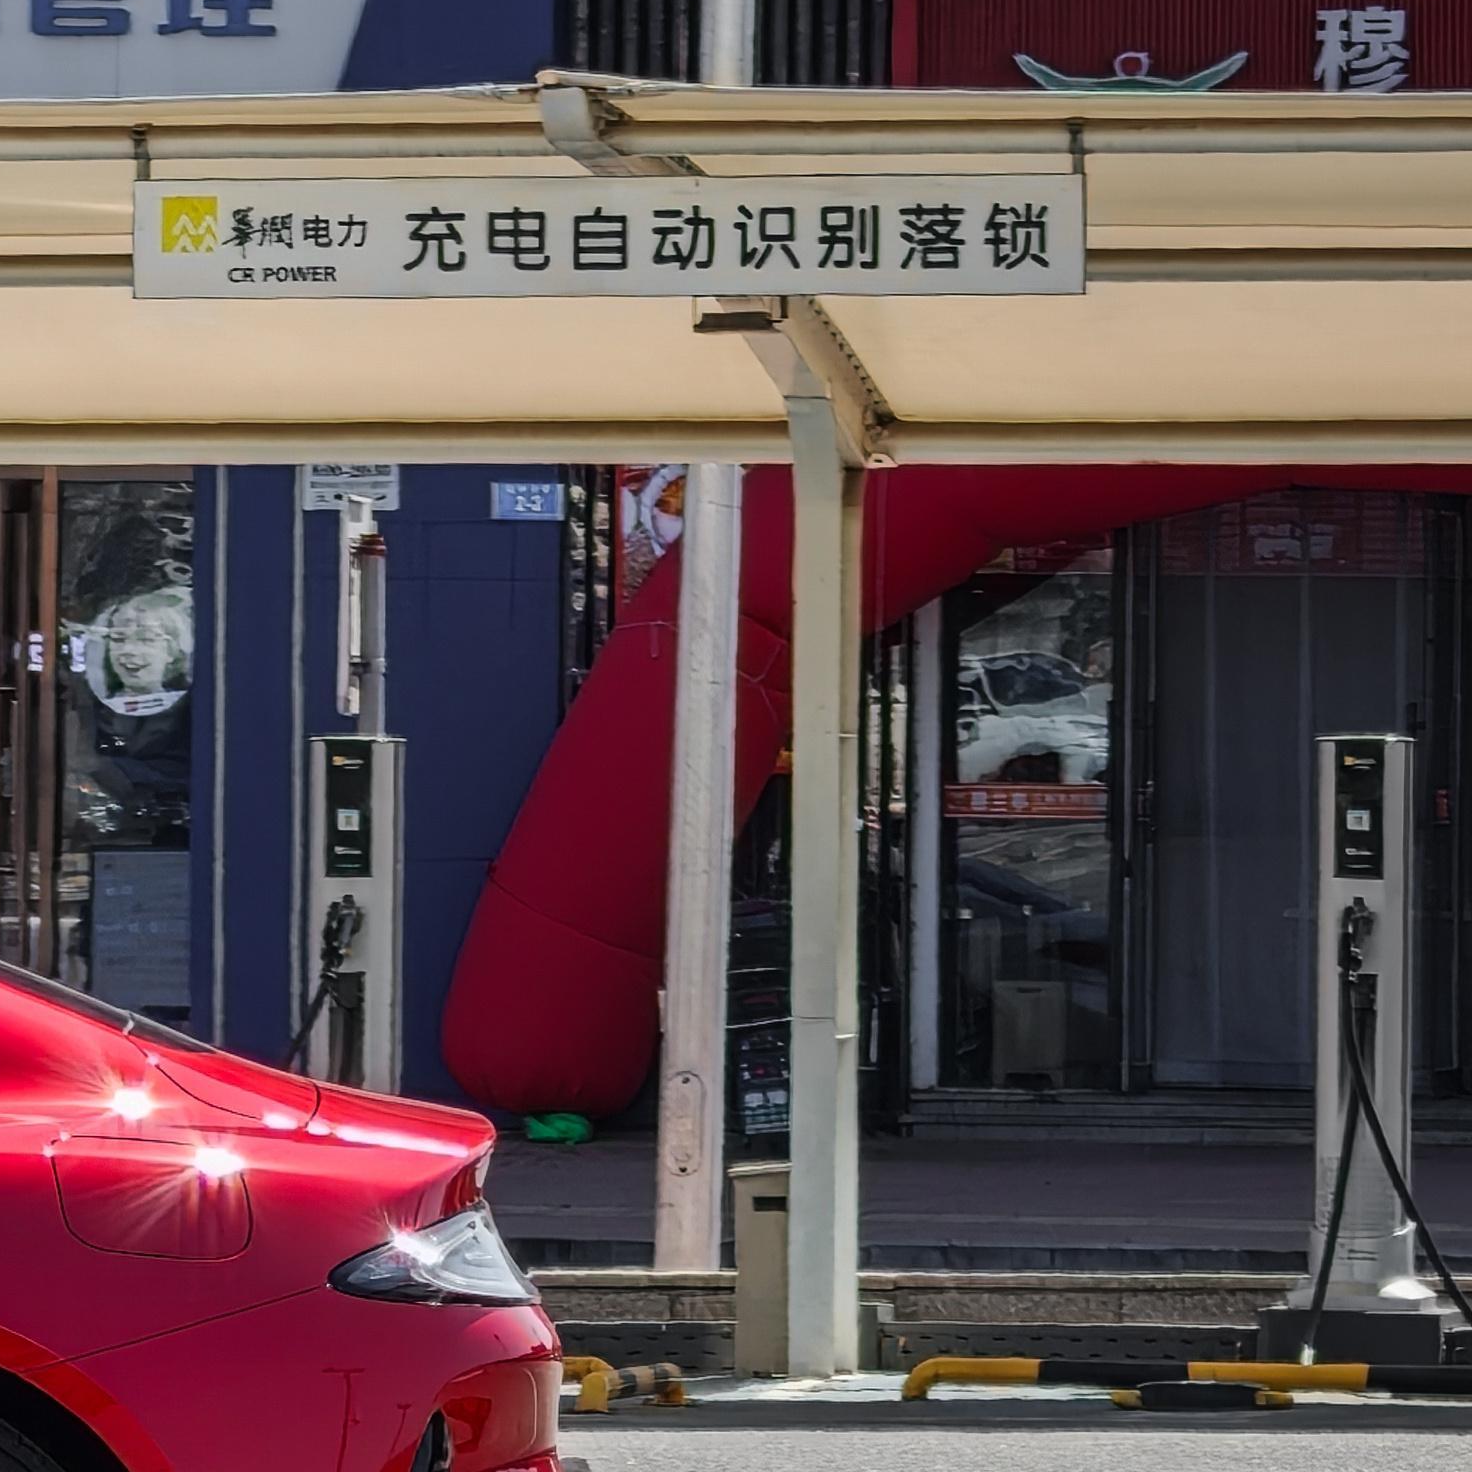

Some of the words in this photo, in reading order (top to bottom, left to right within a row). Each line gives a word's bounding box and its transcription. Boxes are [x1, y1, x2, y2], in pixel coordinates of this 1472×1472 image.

[402, 202, 1052, 275] 充电自动识别落锁
[262, 266, 337, 282] POWER
